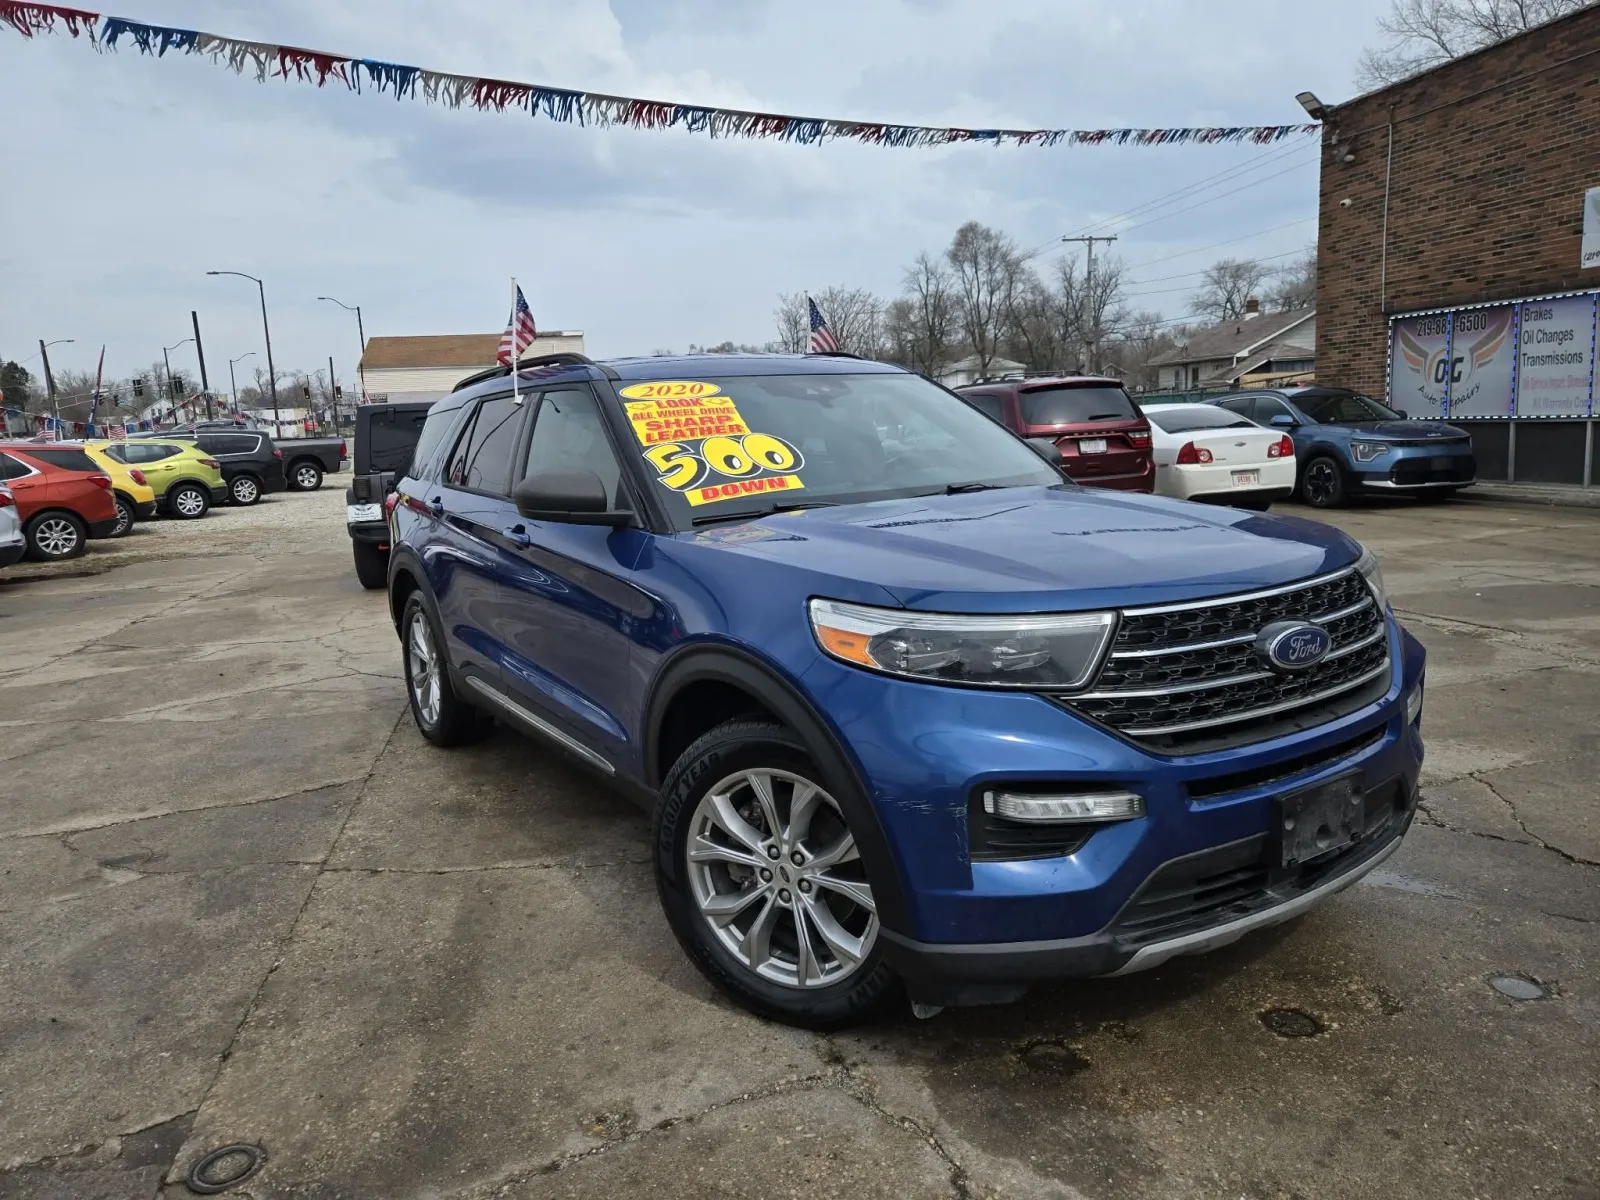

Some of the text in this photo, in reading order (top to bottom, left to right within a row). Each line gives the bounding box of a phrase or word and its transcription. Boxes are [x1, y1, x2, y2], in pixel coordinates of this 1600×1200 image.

[1524, 306, 1553, 322] Brakes
[1522, 328, 1574, 345] Oil Changes
[1522, 350, 1583, 368] Transmissions
[641, 384, 703, 398] 2020
[656, 398, 705, 409] LOOK
[632, 407, 736, 421] ALL WHEEL DRIVE
[645, 415, 734, 431] SHARP
[645, 424, 744, 443] LEATHER
[643, 433, 805, 492] 500
[701, 477, 787, 501] DOWN
[1290, 635, 1321, 660] Ford
